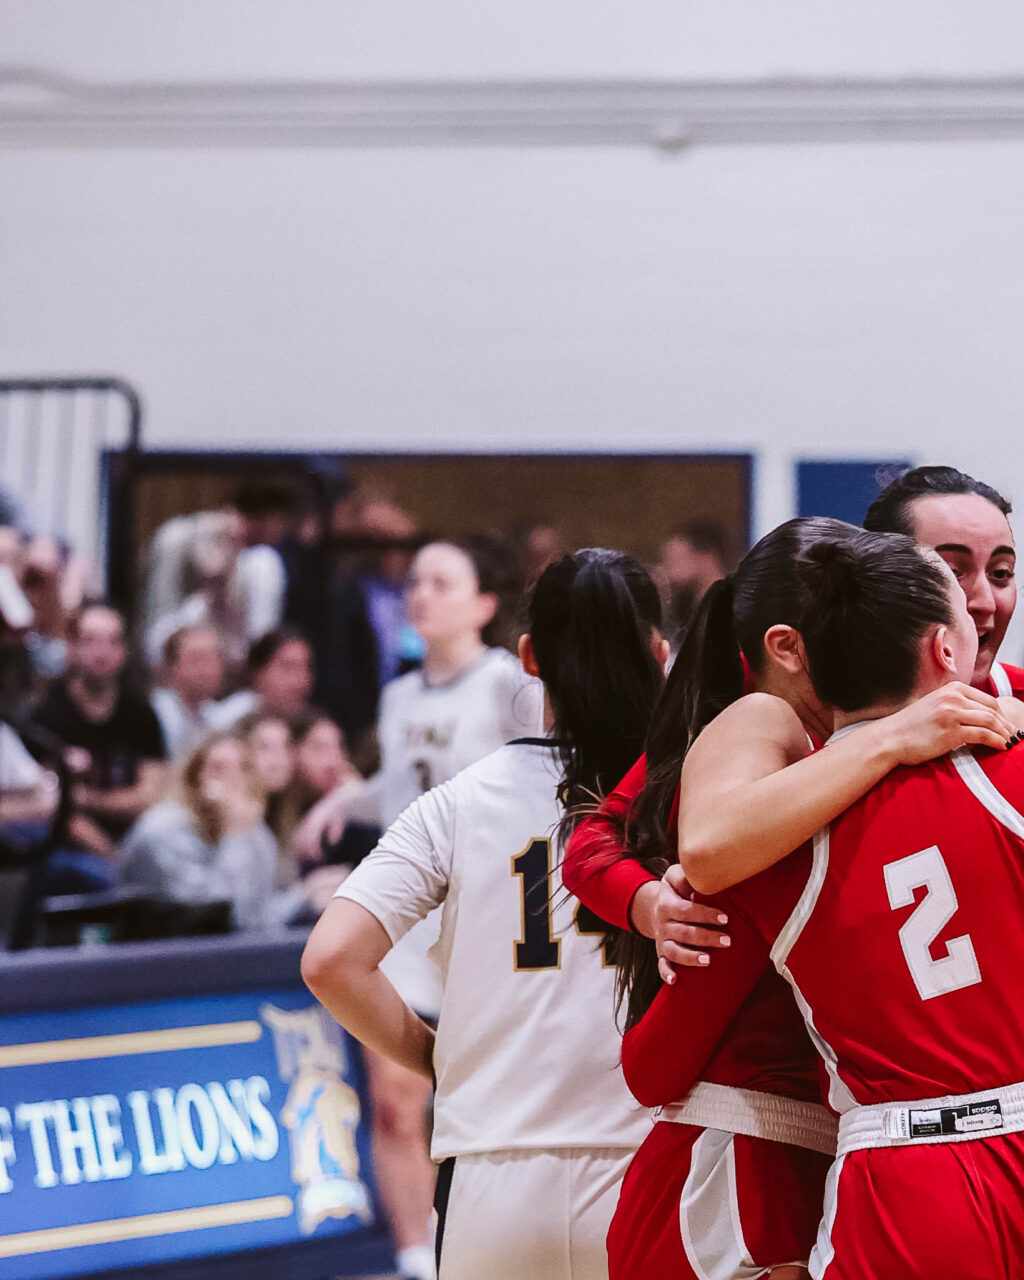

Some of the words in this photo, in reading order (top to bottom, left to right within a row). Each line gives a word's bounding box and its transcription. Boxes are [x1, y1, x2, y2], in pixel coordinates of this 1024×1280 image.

[883, 845, 982, 1001] 2
[14, 1093, 133, 1189] THE
[127, 1075, 279, 1176] LIONS
[971, 1105, 998, 1115] adidas
